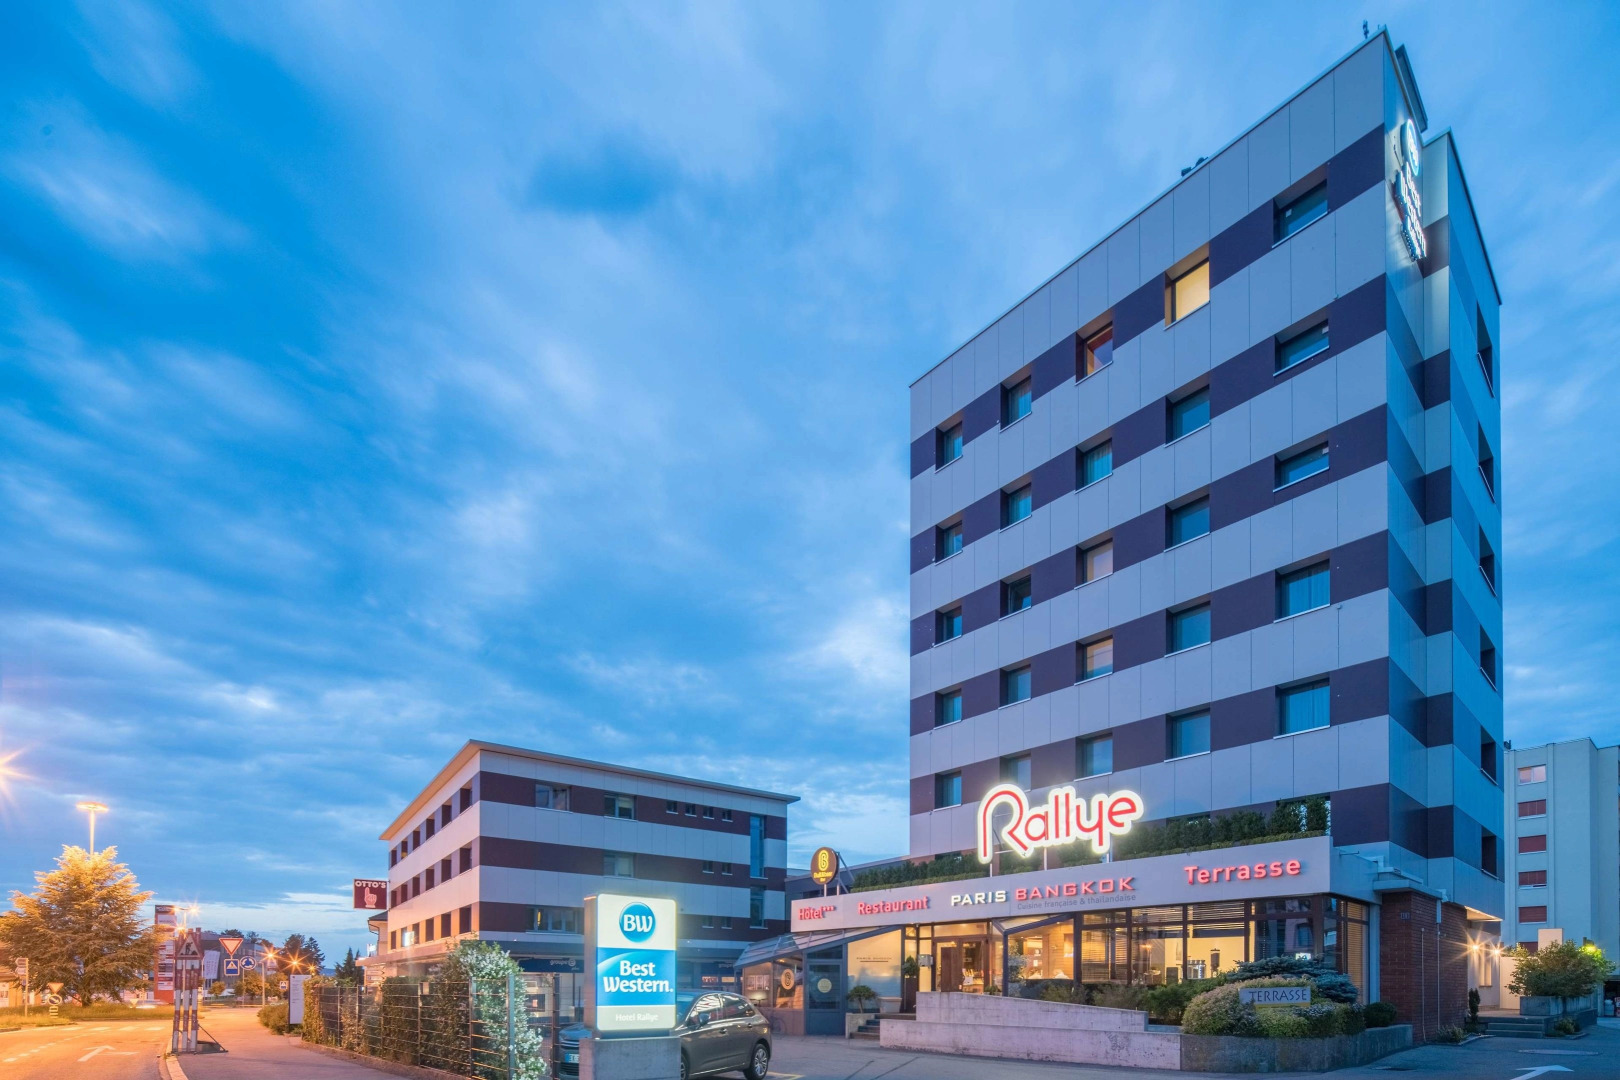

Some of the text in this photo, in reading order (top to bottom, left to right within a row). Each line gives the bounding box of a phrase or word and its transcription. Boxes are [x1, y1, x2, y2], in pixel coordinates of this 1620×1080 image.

[980, 788, 1140, 860] Rallye
[1184, 859, 1301, 885] Terrasse
[355, 880, 387, 889] OTTO'S
[951, 877, 1134, 906] PARIS BANGKOK
[857, 896, 929, 915] Restaurant
[1017, 902, 1043, 910] Cuisine
[1044, 898, 1078, 908] française
[1079, 897, 1086, 905] &
[623, 914, 653, 933] BW
[620, 960, 656, 977] Best
[1249, 988, 1307, 1002] TERRASSE
[615, 1013, 659, 1023] Hotel Rallye
